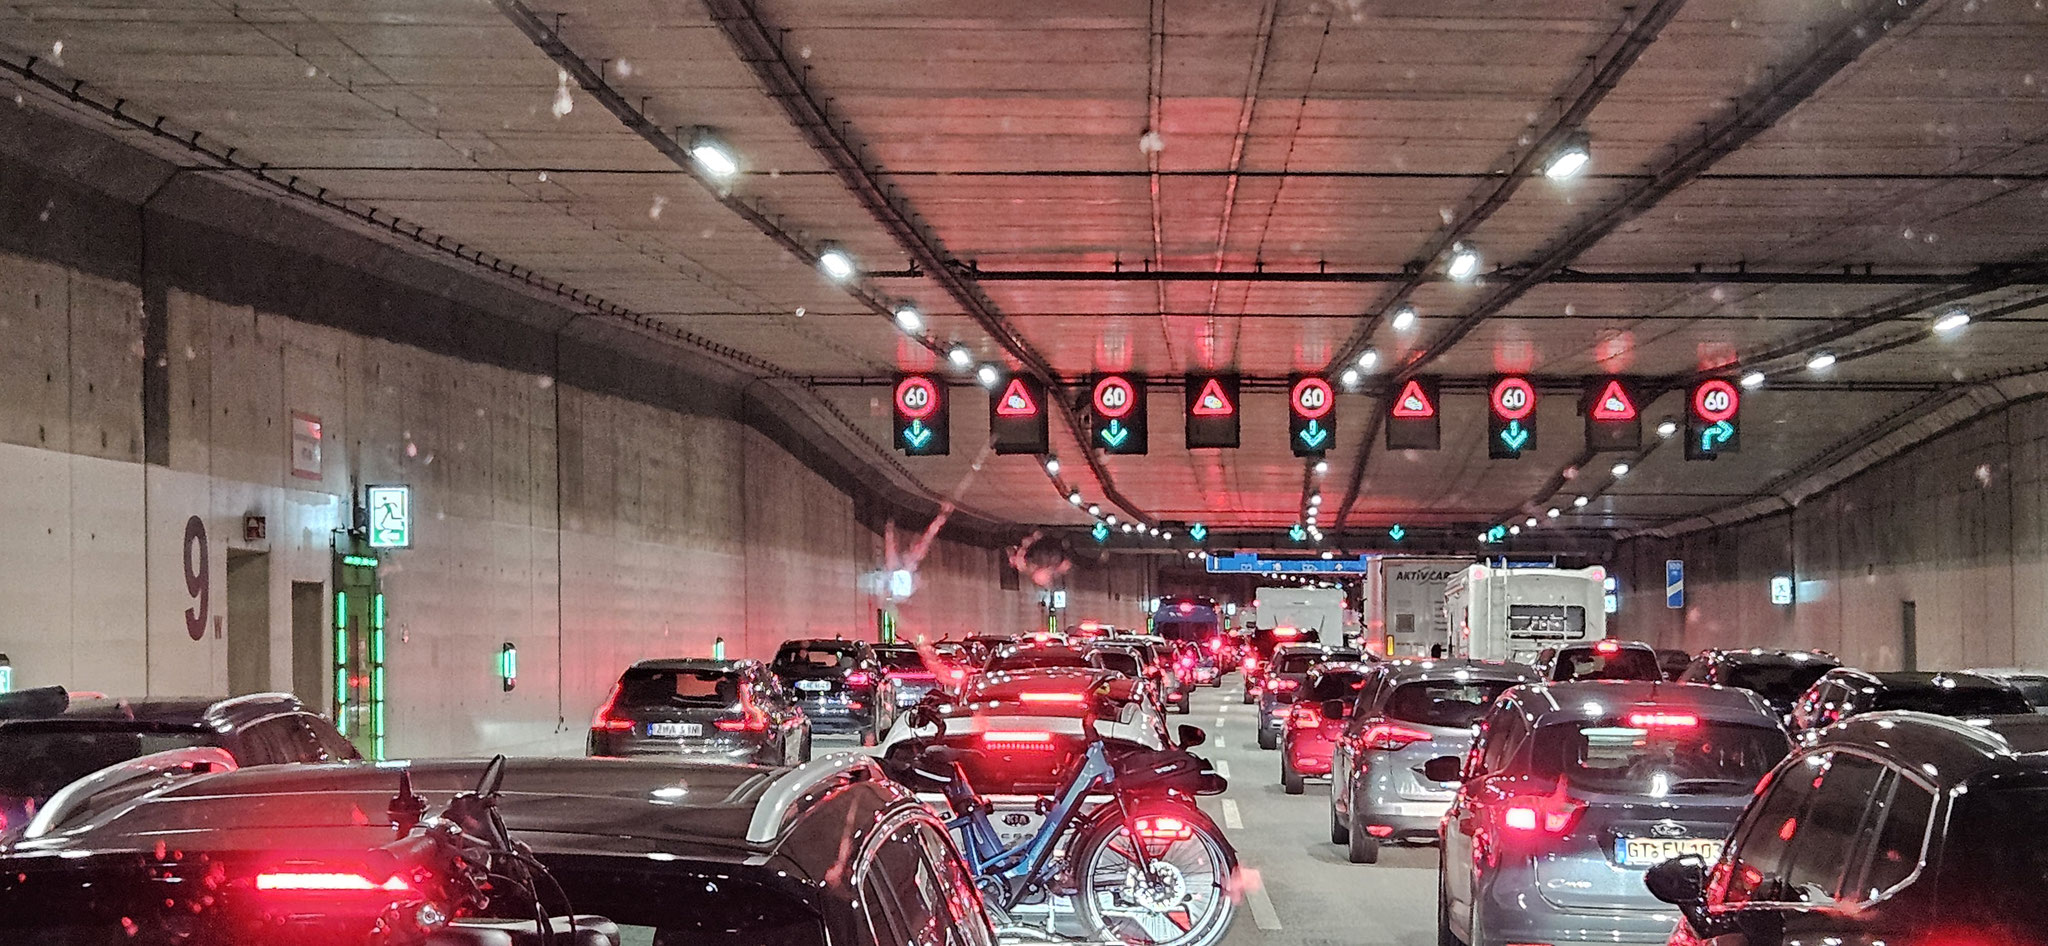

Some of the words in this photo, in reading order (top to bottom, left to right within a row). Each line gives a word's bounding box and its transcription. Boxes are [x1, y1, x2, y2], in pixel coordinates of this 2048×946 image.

[904, 387, 928, 406] 60
[1102, 386, 1126, 407] 60
[1301, 387, 1325, 407] 60
[1502, 386, 1526, 408] 60
[1704, 390, 1729, 411] 60
[183, 514, 209, 641] 9
[1006, 814, 1027, 824] KIA
